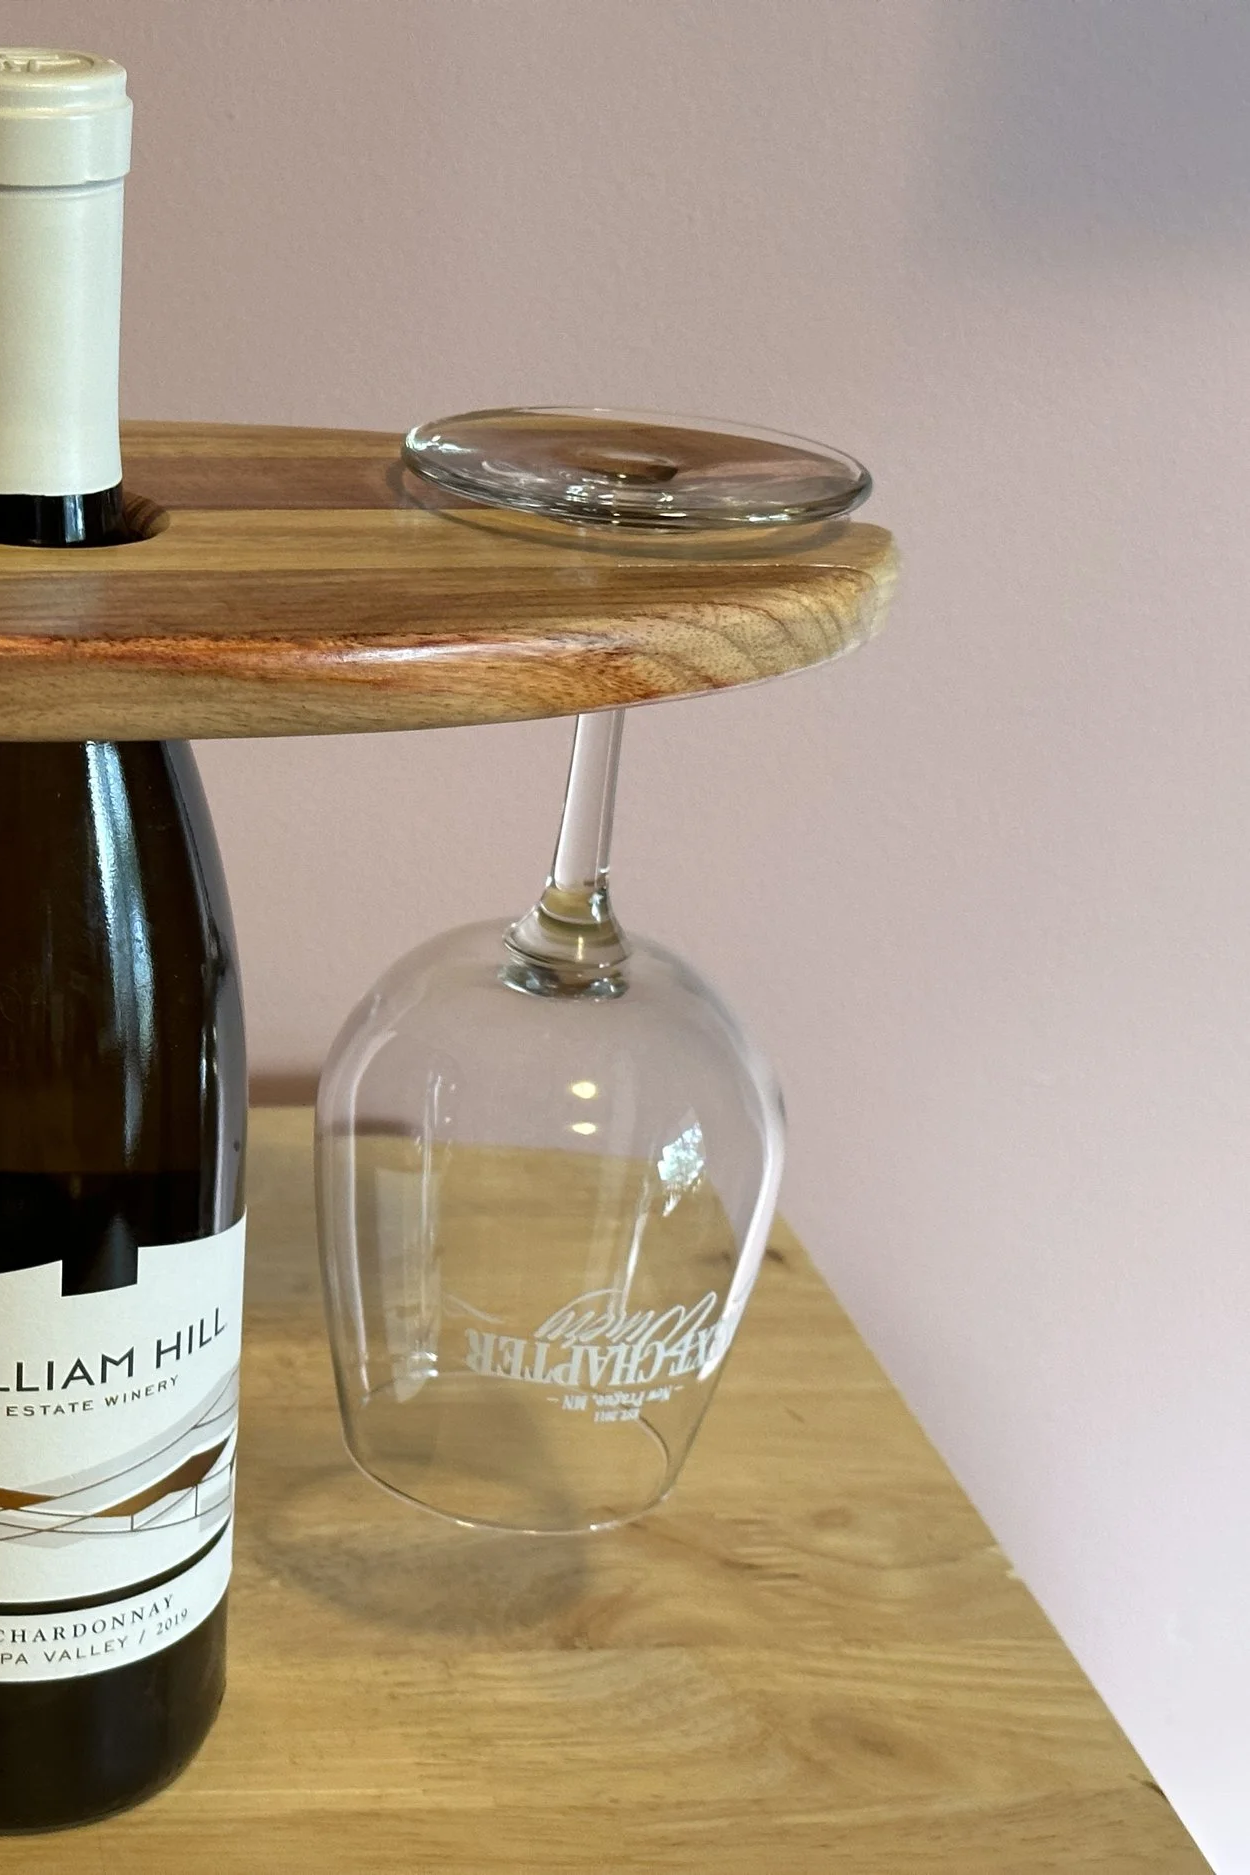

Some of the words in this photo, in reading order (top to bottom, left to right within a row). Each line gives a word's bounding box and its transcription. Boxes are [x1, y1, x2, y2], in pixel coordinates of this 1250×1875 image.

[155, 1307, 228, 1369] HILL
[534, 1289, 717, 1349] Winery
[464, 1328, 665, 1388] CHAPTER
[5, 1399, 94, 1417] ESTATE
[104, 1374, 180, 1407] WINERY
[44, 1635, 128, 1663] VALLEY
[156, 1608, 188, 1636] 2019
